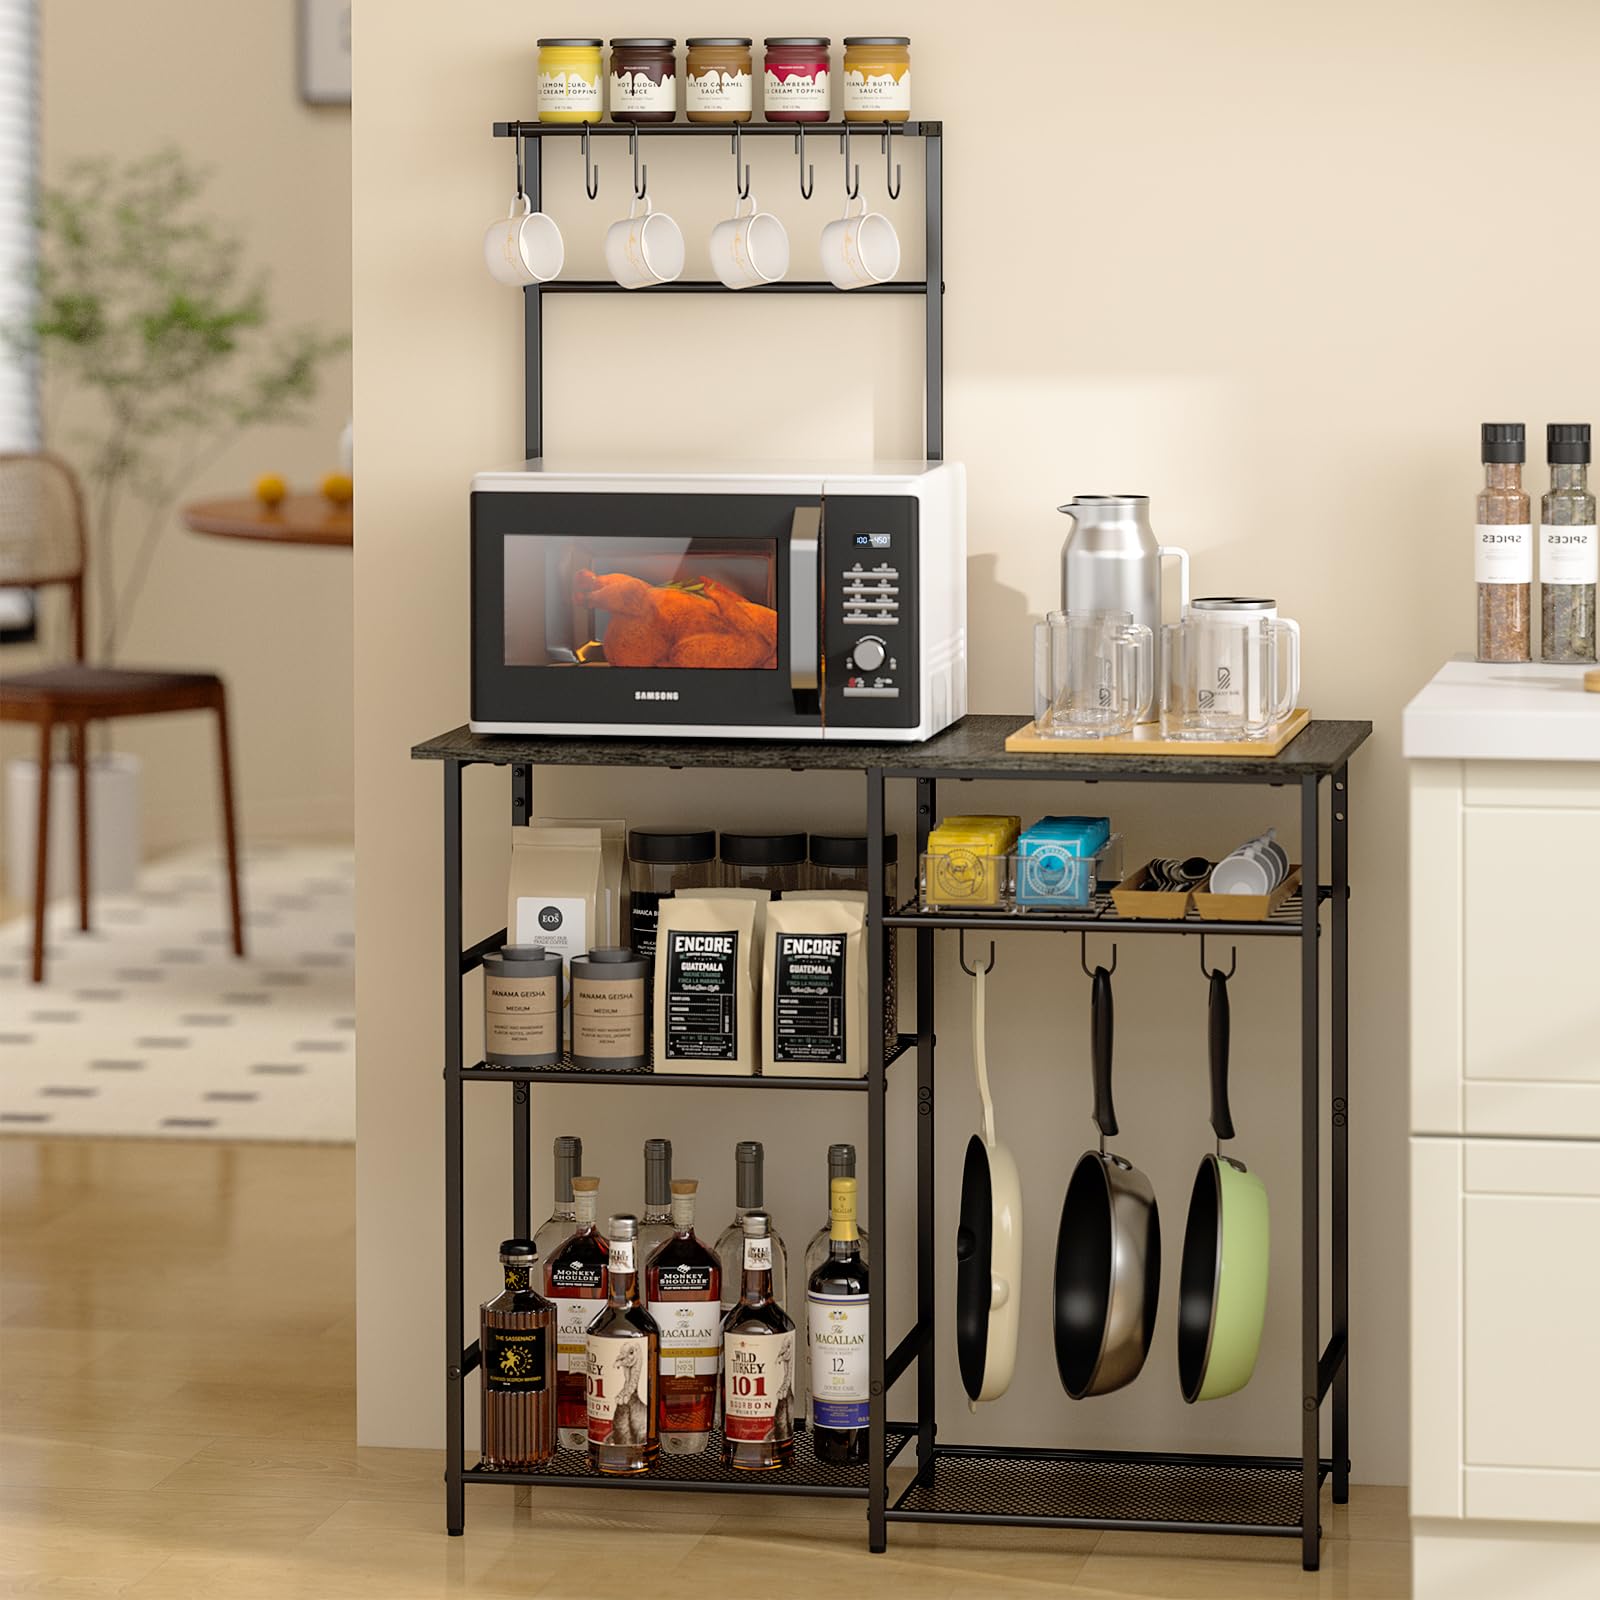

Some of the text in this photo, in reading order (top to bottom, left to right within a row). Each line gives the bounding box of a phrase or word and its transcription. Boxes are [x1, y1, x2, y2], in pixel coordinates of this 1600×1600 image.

[542, 914, 560, 923] EOS
[675, 936, 733, 954] ENCORE
[783, 938, 842, 956] ENCORE
[681, 962, 724, 972] GUATEMALA
[789, 964, 833, 975] GUATEMALA
[491, 990, 546, 998] PANAMA GEISHA
[608, 993, 634, 1001] GEISHA
[558, 1325, 587, 1335] ACAL
[831, 1324, 844, 1335] The
[815, 1332, 865, 1345] MACALLAN
[732, 1350, 757, 1363] WILD
[732, 1362, 766, 1374] TURKEY
[832, 1358, 845, 1373] 12
[587, 1375, 606, 1398] 01
[732, 1375, 768, 1397] 101
[729, 1400, 773, 1410] BOURBON
